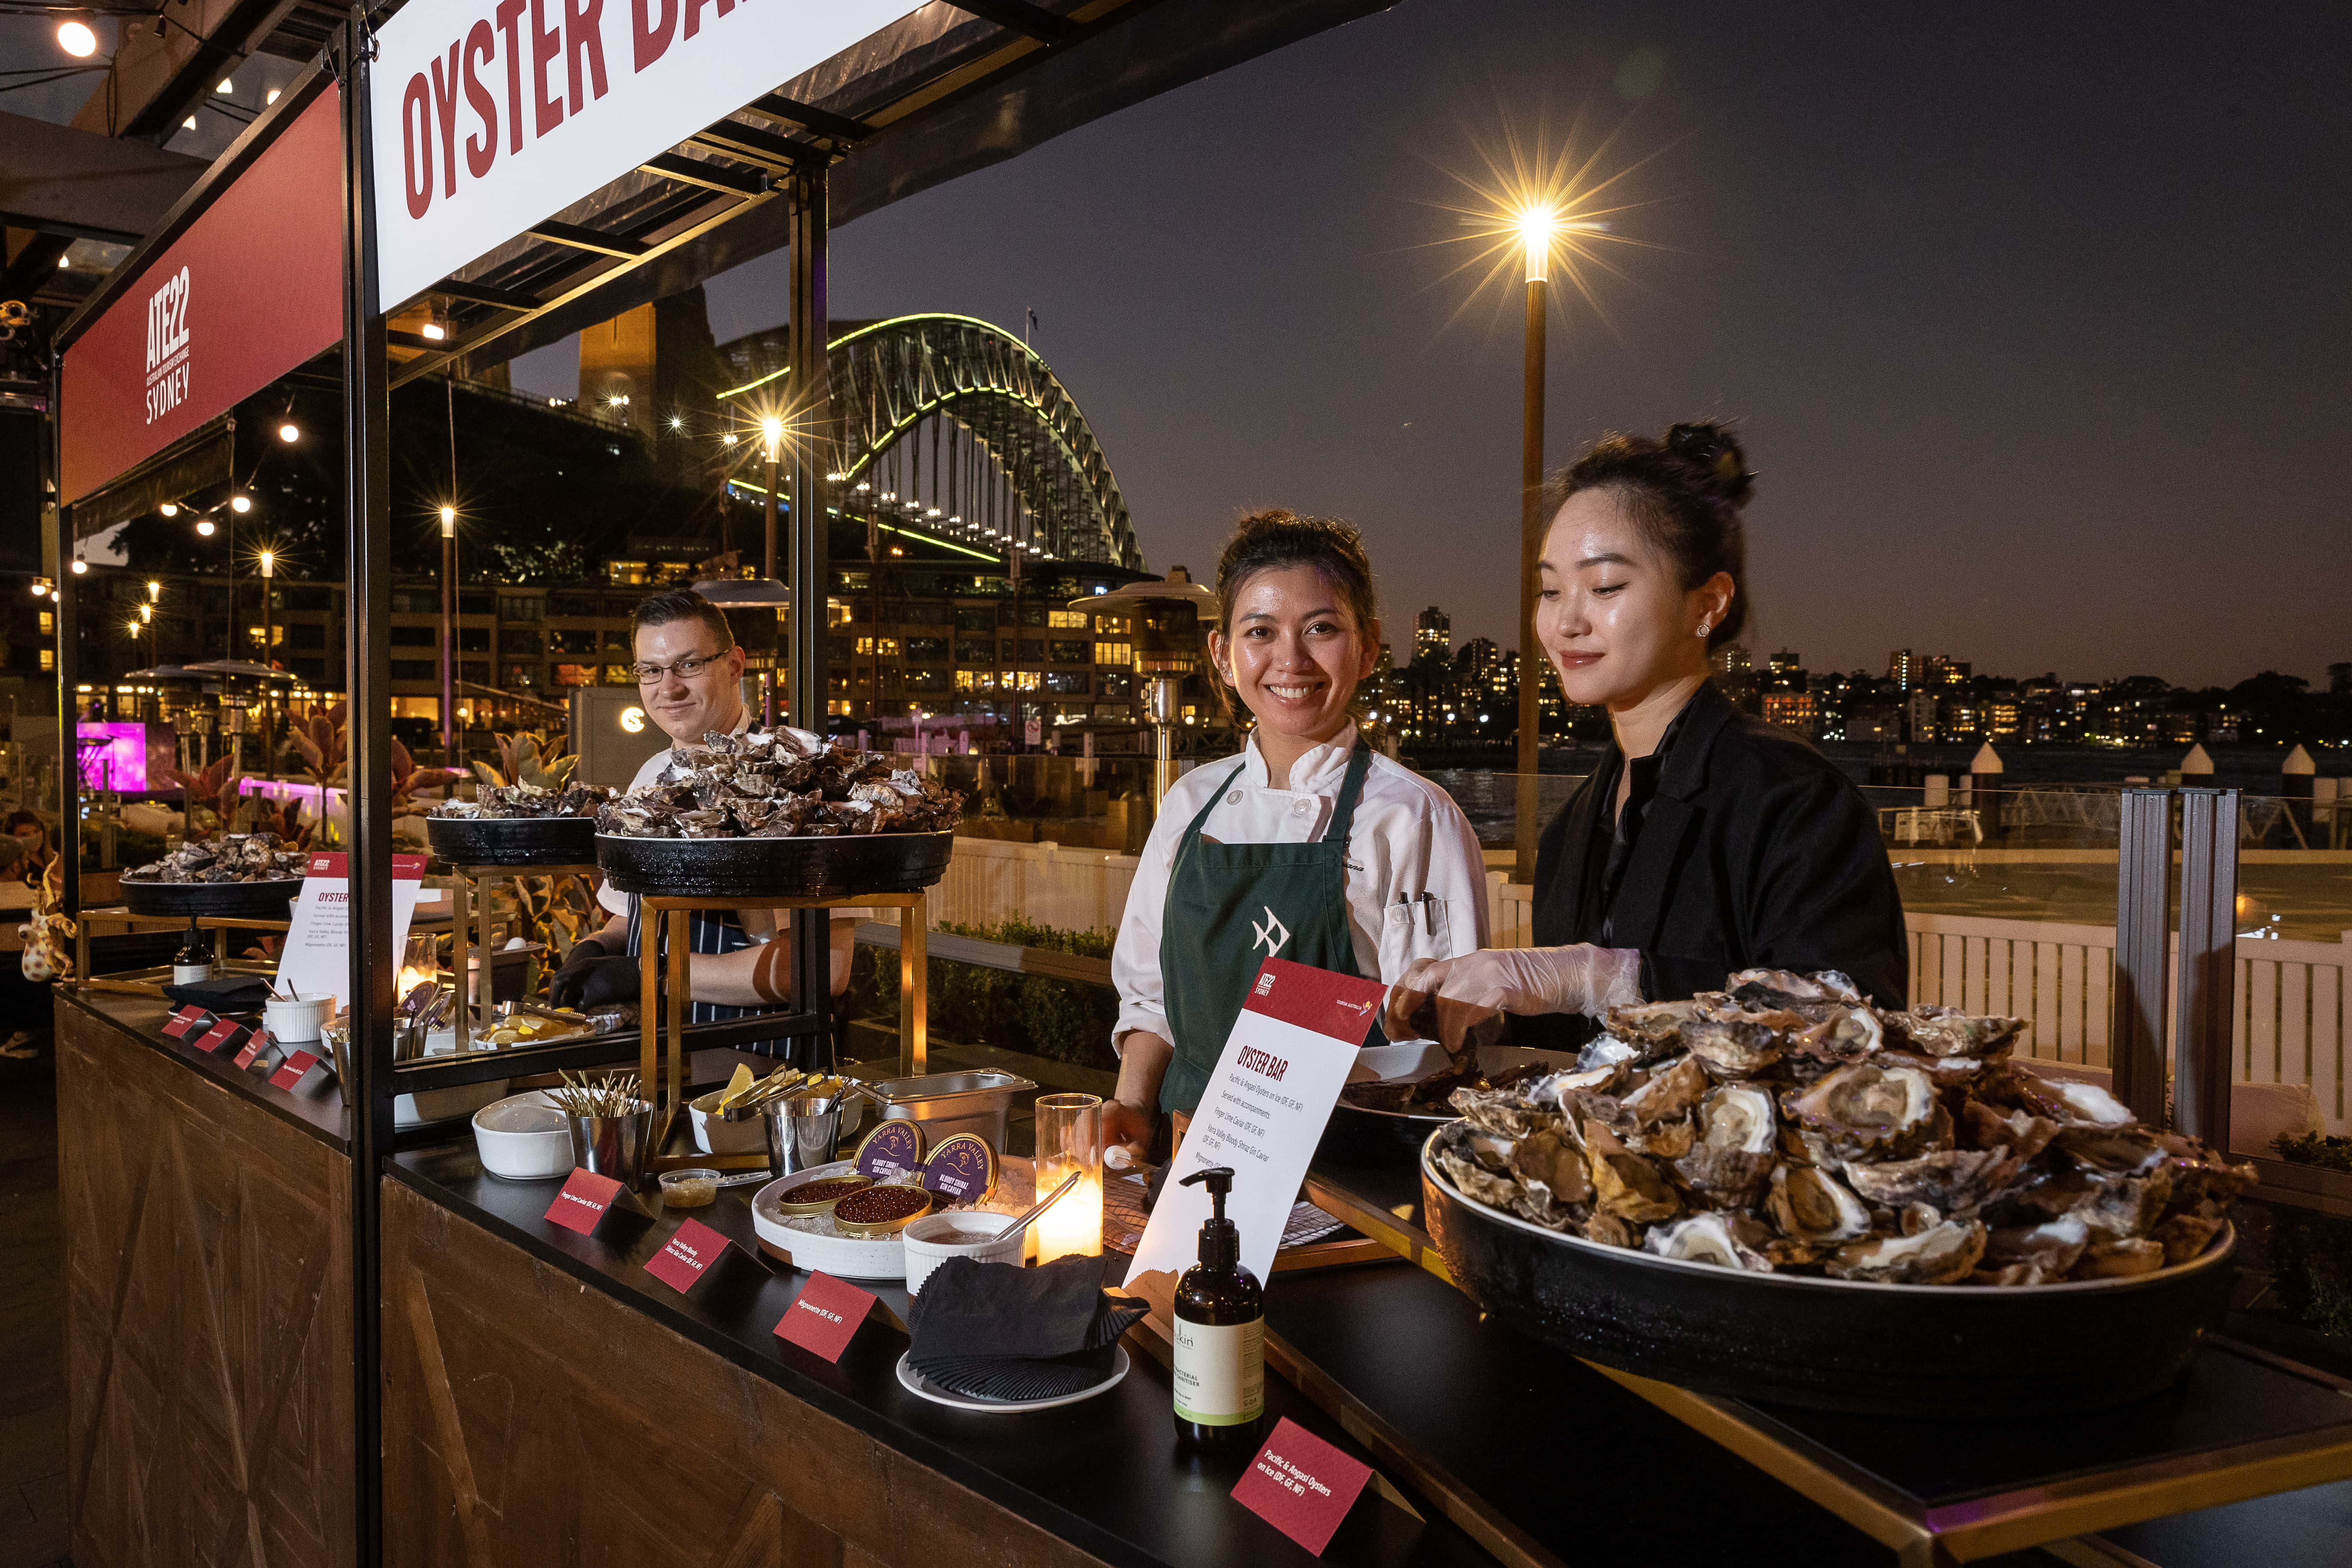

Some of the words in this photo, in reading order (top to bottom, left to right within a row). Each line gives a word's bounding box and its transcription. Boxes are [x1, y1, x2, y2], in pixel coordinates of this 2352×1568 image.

[403, 0, 609, 220] OYSTER
[147, 266, 190, 373] ATE22
[146, 361, 190, 425] SYDNEY
[318, 892, 349, 902] OYSTER
[1255, 987, 1270, 996] SYDNEY
[1259, 973, 1276, 988] ATE22
[1237, 1045, 1270, 1075] OYSTER
[1265, 1056, 1288, 1082] BAR
[1222, 1090, 1234, 1102] Served
[1233, 1096, 1242, 1106] with
[1228, 1073, 1241, 1085] Pacific
[1244, 1080, 1256, 1092] Angasi
[1256, 1085, 1270, 1098] Oysters
[1280, 1096, 1289, 1107] (DF,
[1295, 1102, 1303, 1113] NF)
[1214, 1107, 1226, 1118] Finger
[1224, 1112, 1234, 1123] Lime
[1233, 1116, 1245, 1128] Caviar
[1244, 1122, 1252, 1133] (DF,
[873, 1127, 895, 1144] YARRA
[898, 1127, 912, 1149] VALLEY
[1207, 1123, 1216, 1135] Yarra
[1216, 1127, 1227, 1142] Valley
[1225, 1133, 1239, 1148] Bloody
[1237, 1140, 1250, 1152] Shiraz
[1256, 1150, 1269, 1162] Caviar
[872, 1158, 886, 1167] BLOODY
[940, 1142, 965, 1159] YARRA
[968, 1143, 983, 1170] VALLEY
[1195, 1151, 1214, 1168] Mignonette
[939, 1174, 955, 1185] BLOODY
[954, 1179, 969, 1190] SHIRAZ
[940, 1182, 948, 1191] GIN
[947, 1185, 962, 1196] CAVIAR
[561, 1191, 572, 1199] Finger
[665, 1245, 676, 1254] Shiraz
[678, 1253, 688, 1262] Caviar
[672, 1238, 680, 1246] Yarra
[679, 1241, 689, 1252] Valley
[686, 1246, 698, 1257] Bloody
[797, 1299, 821, 1314] Mignonette
[819, 1309, 829, 1319] (DF,
[827, 1312, 835, 1322] GF,
[833, 1315, 843, 1324] NF)
[1174, 1324, 1193, 1347] ukin
[1257, 1462, 1266, 1472] on
[1265, 1465, 1275, 1477] Ice
[1273, 1471, 1286, 1485] (DF,
[1284, 1478, 1295, 1491] GF,
[1292, 1483, 1305, 1497] NF)
[1264, 1449, 1284, 1467] Pacific
[1283, 1461, 1290, 1471] &
[1288, 1465, 1311, 1482] Angasi
[1308, 1477, 1331, 1497] Oysters
